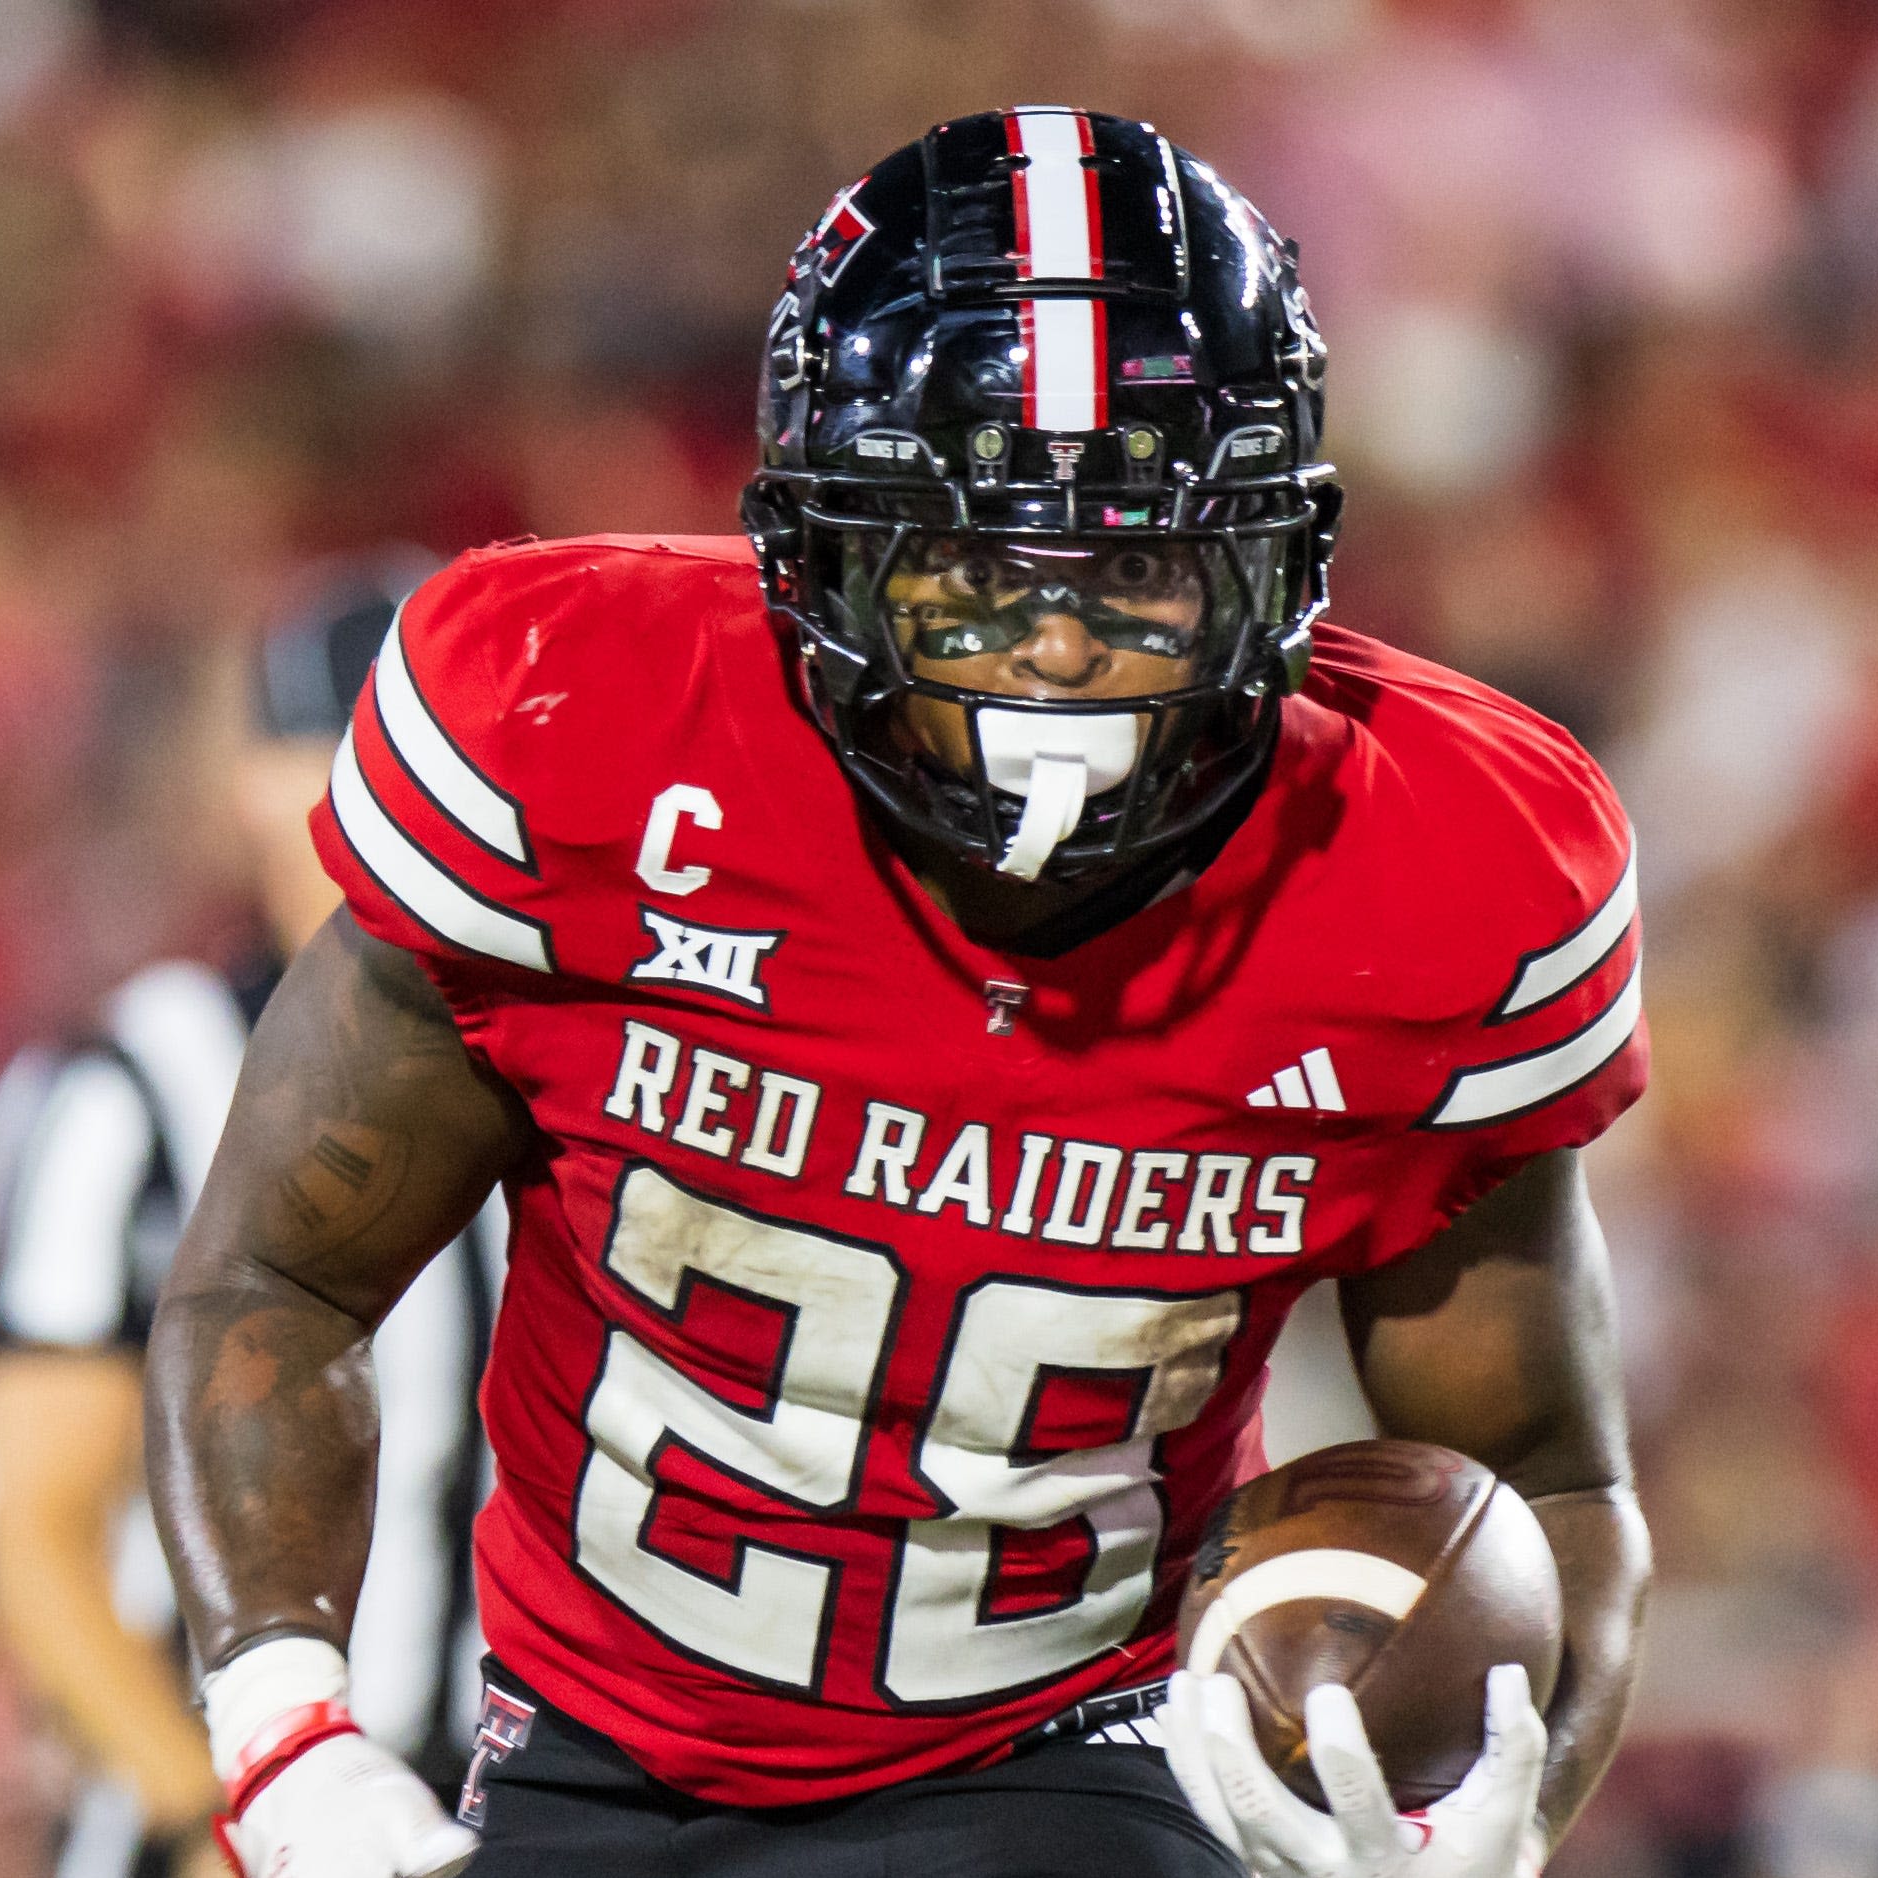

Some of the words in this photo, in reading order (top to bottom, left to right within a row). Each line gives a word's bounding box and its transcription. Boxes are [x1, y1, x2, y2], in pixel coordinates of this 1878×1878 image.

[634, 782, 724, 897] C
[625, 904, 784, 1011] XII
[601, 1017, 823, 1181] RED
[843, 1100, 1319, 1257] RAIDERS
[572, 1158, 1248, 1714] 28
